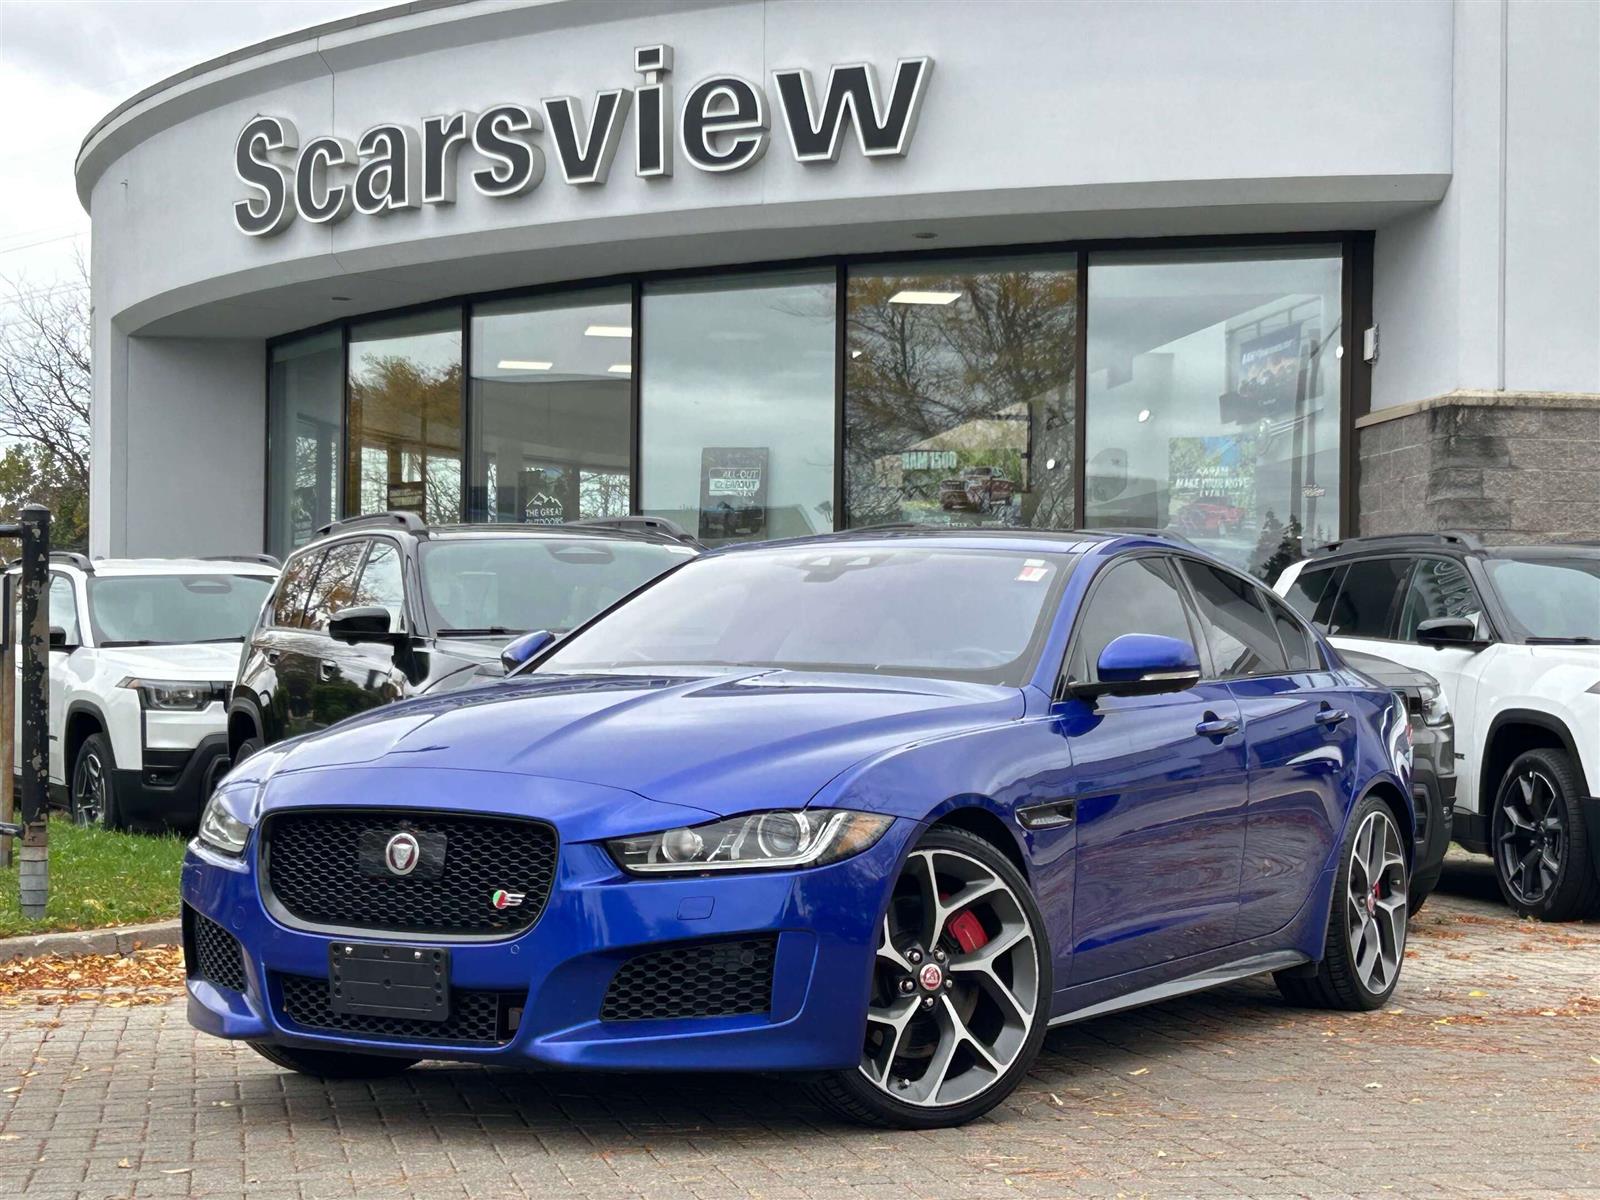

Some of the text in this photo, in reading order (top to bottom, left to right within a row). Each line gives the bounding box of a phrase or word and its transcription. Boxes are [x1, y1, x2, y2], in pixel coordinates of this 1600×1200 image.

[233, 44, 935, 238] Scarsview
[525, 508, 563, 517] THE GREAT
